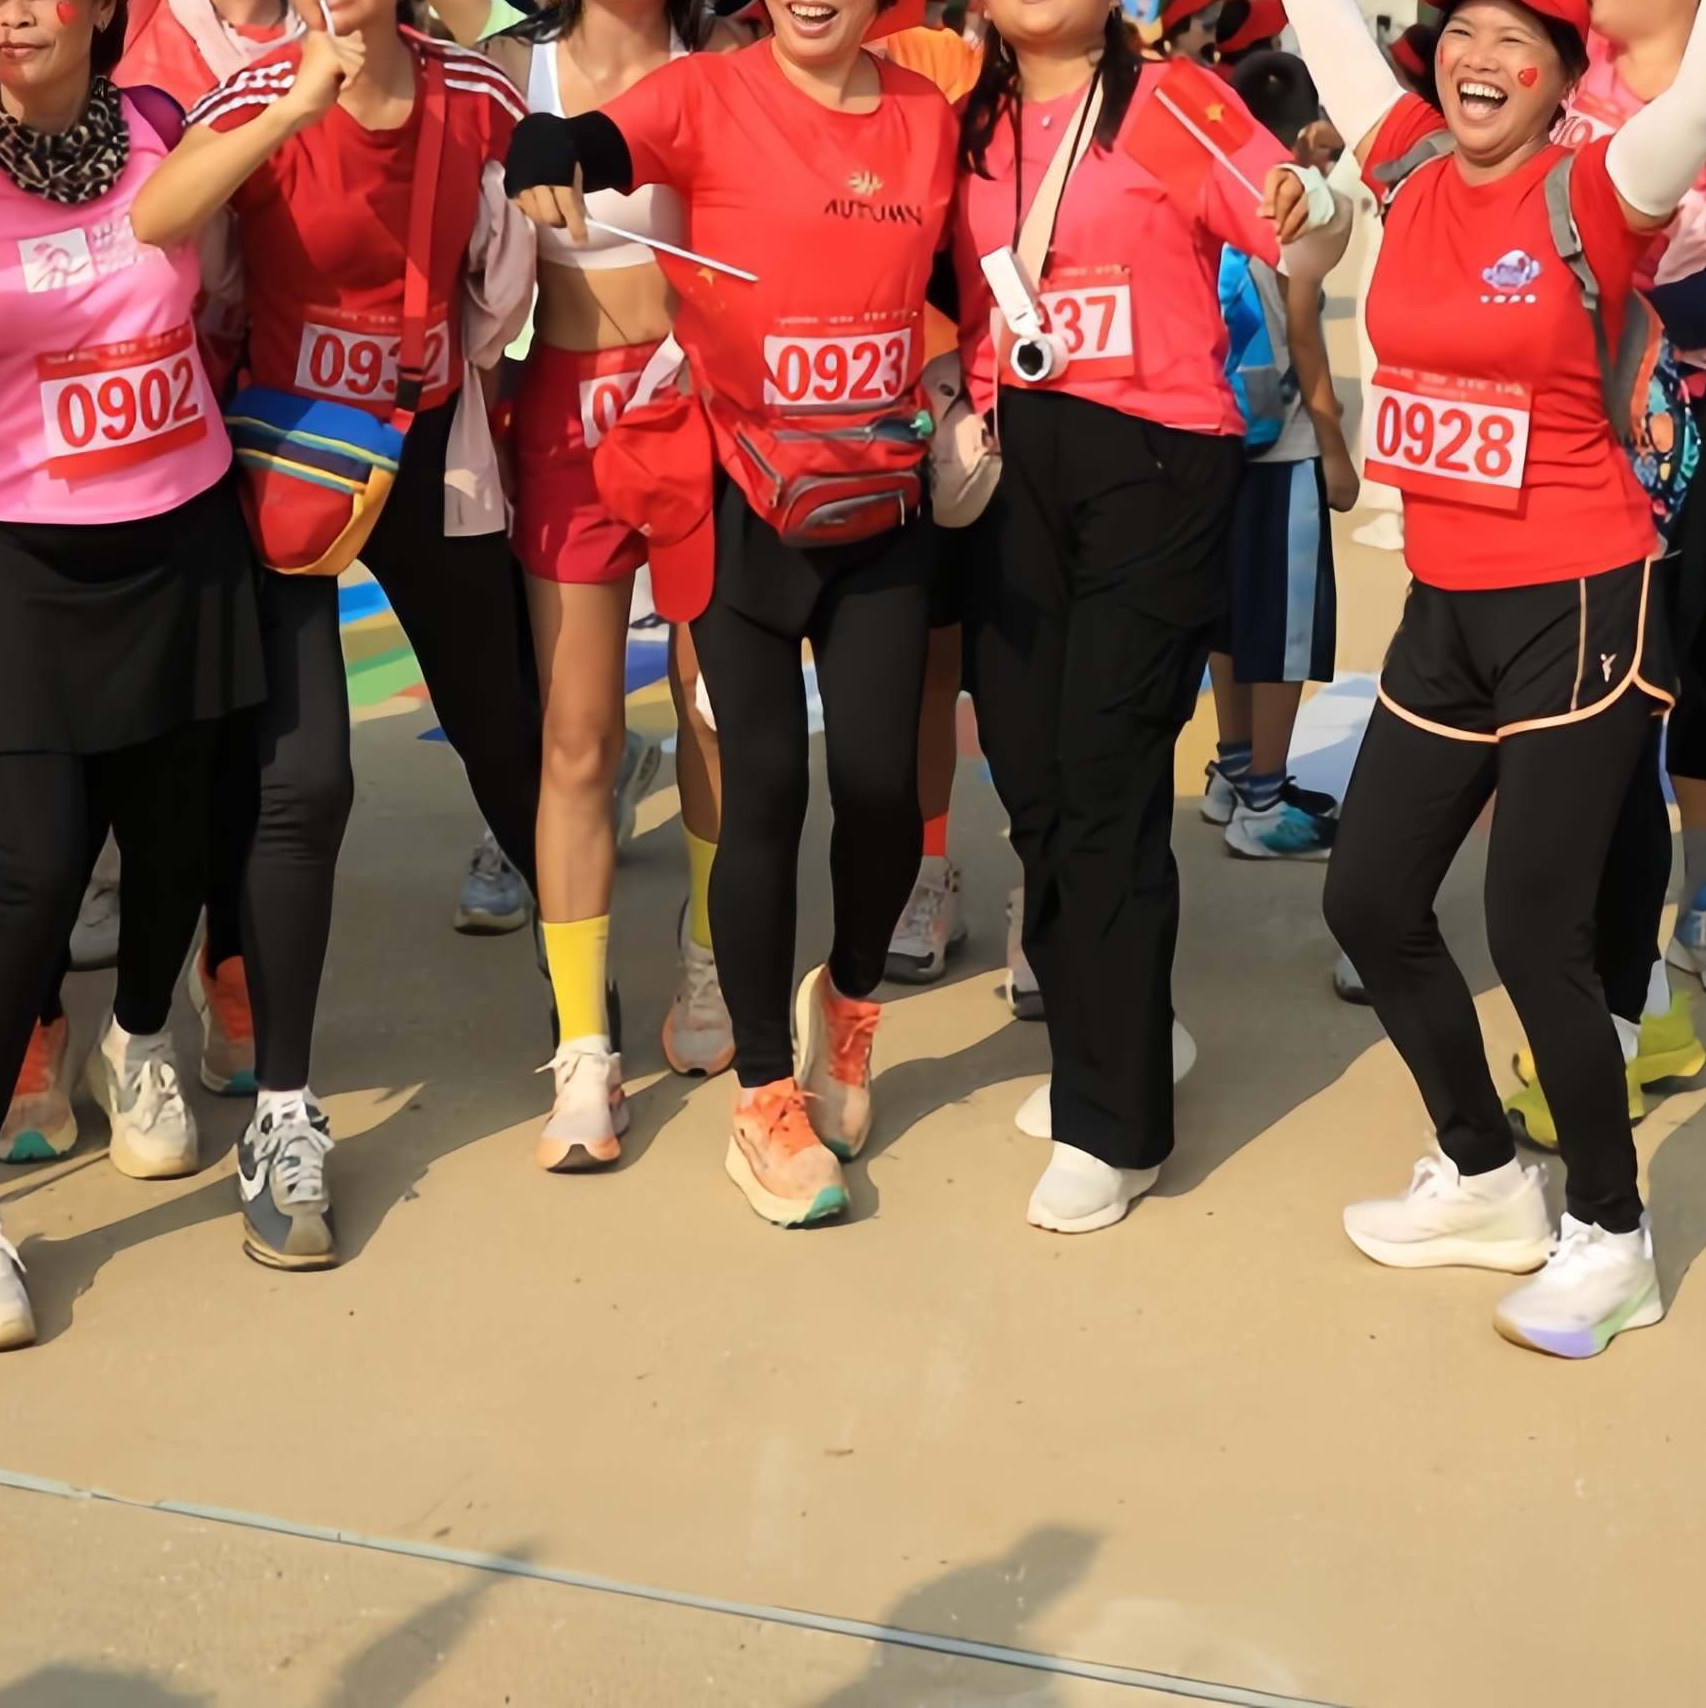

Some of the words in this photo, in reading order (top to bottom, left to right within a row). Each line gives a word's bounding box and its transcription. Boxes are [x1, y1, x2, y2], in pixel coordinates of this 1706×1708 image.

[309, 333, 444, 395] 092
[777, 338, 906, 403] 0923
[56, 355, 199, 448] 0902
[1376, 395, 1515, 478] 0928
